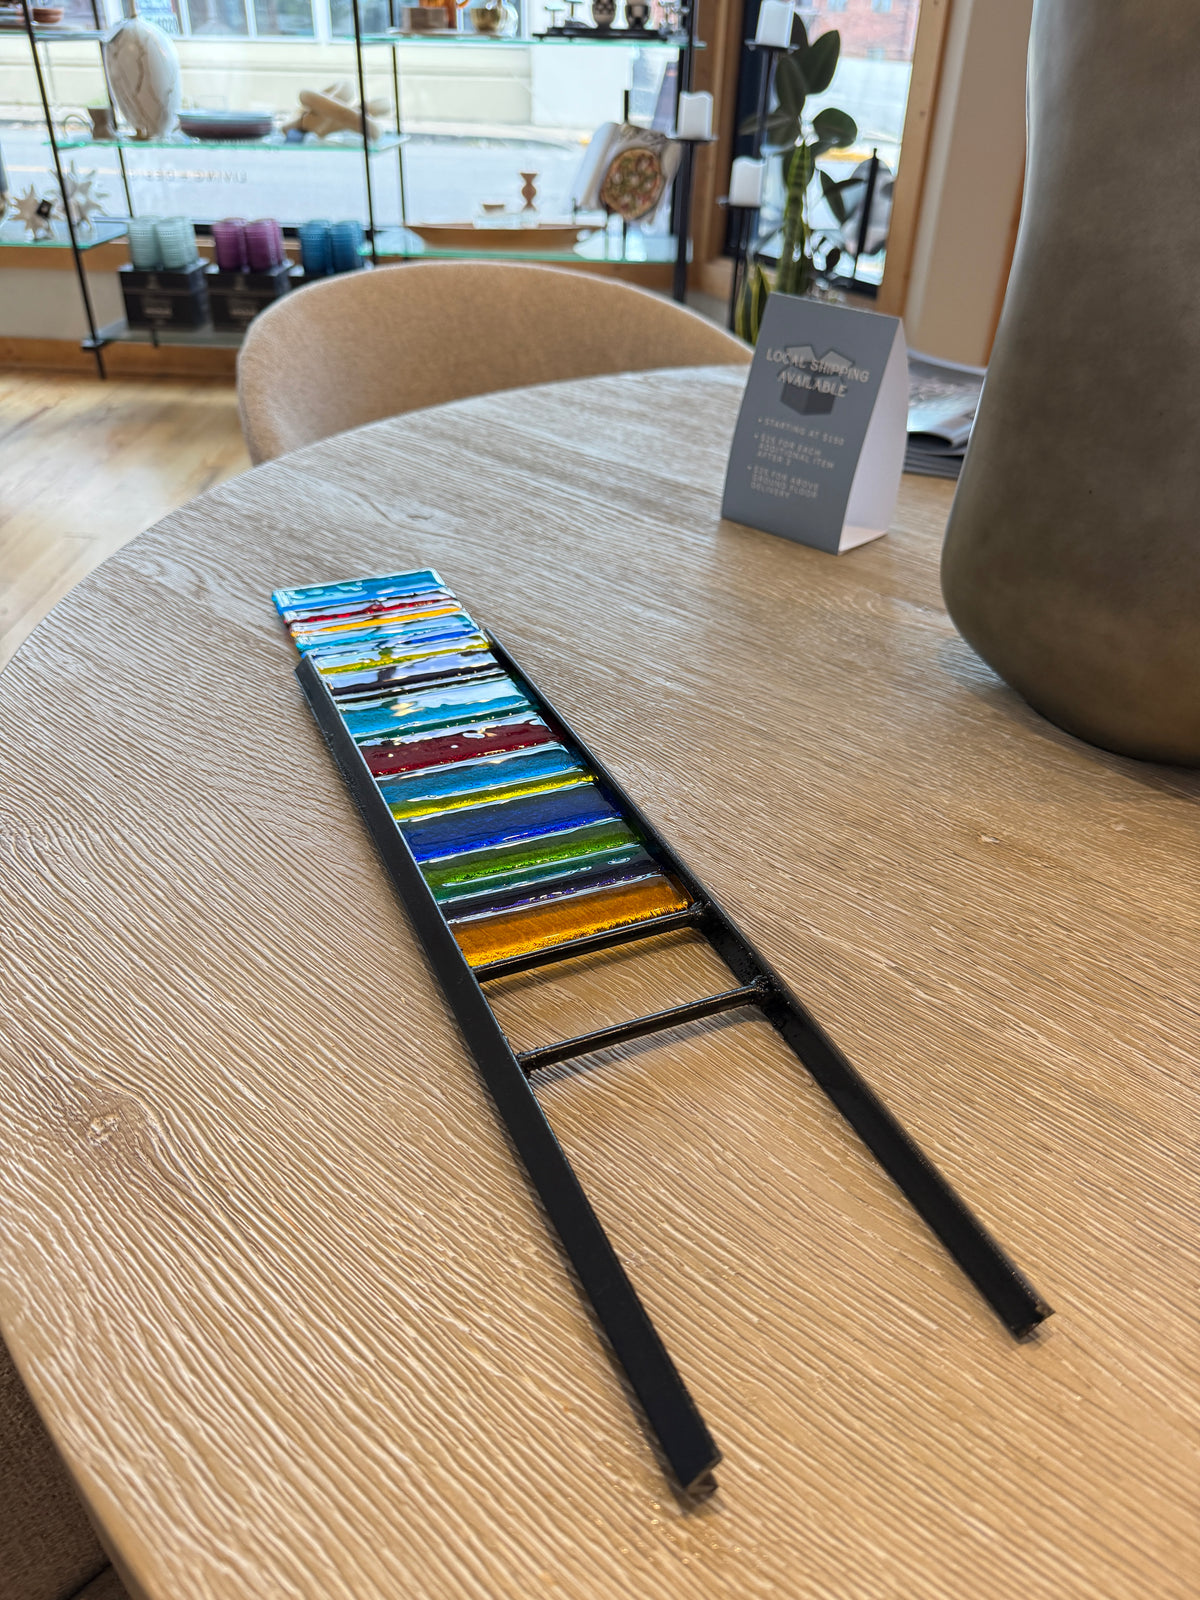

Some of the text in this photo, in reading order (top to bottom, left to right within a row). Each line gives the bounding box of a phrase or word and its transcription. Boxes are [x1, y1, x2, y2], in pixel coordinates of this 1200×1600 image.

[766, 348, 870, 383] LOCAL SHIPPING
[777, 371, 848, 397] AVAILABLE
[764, 417, 806, 436] STARTING
[808, 430, 820, 439] AT
[778, 439, 795, 450] FOR
[797, 444, 821, 457] EACH
[790, 477, 819, 492] ABOVE
